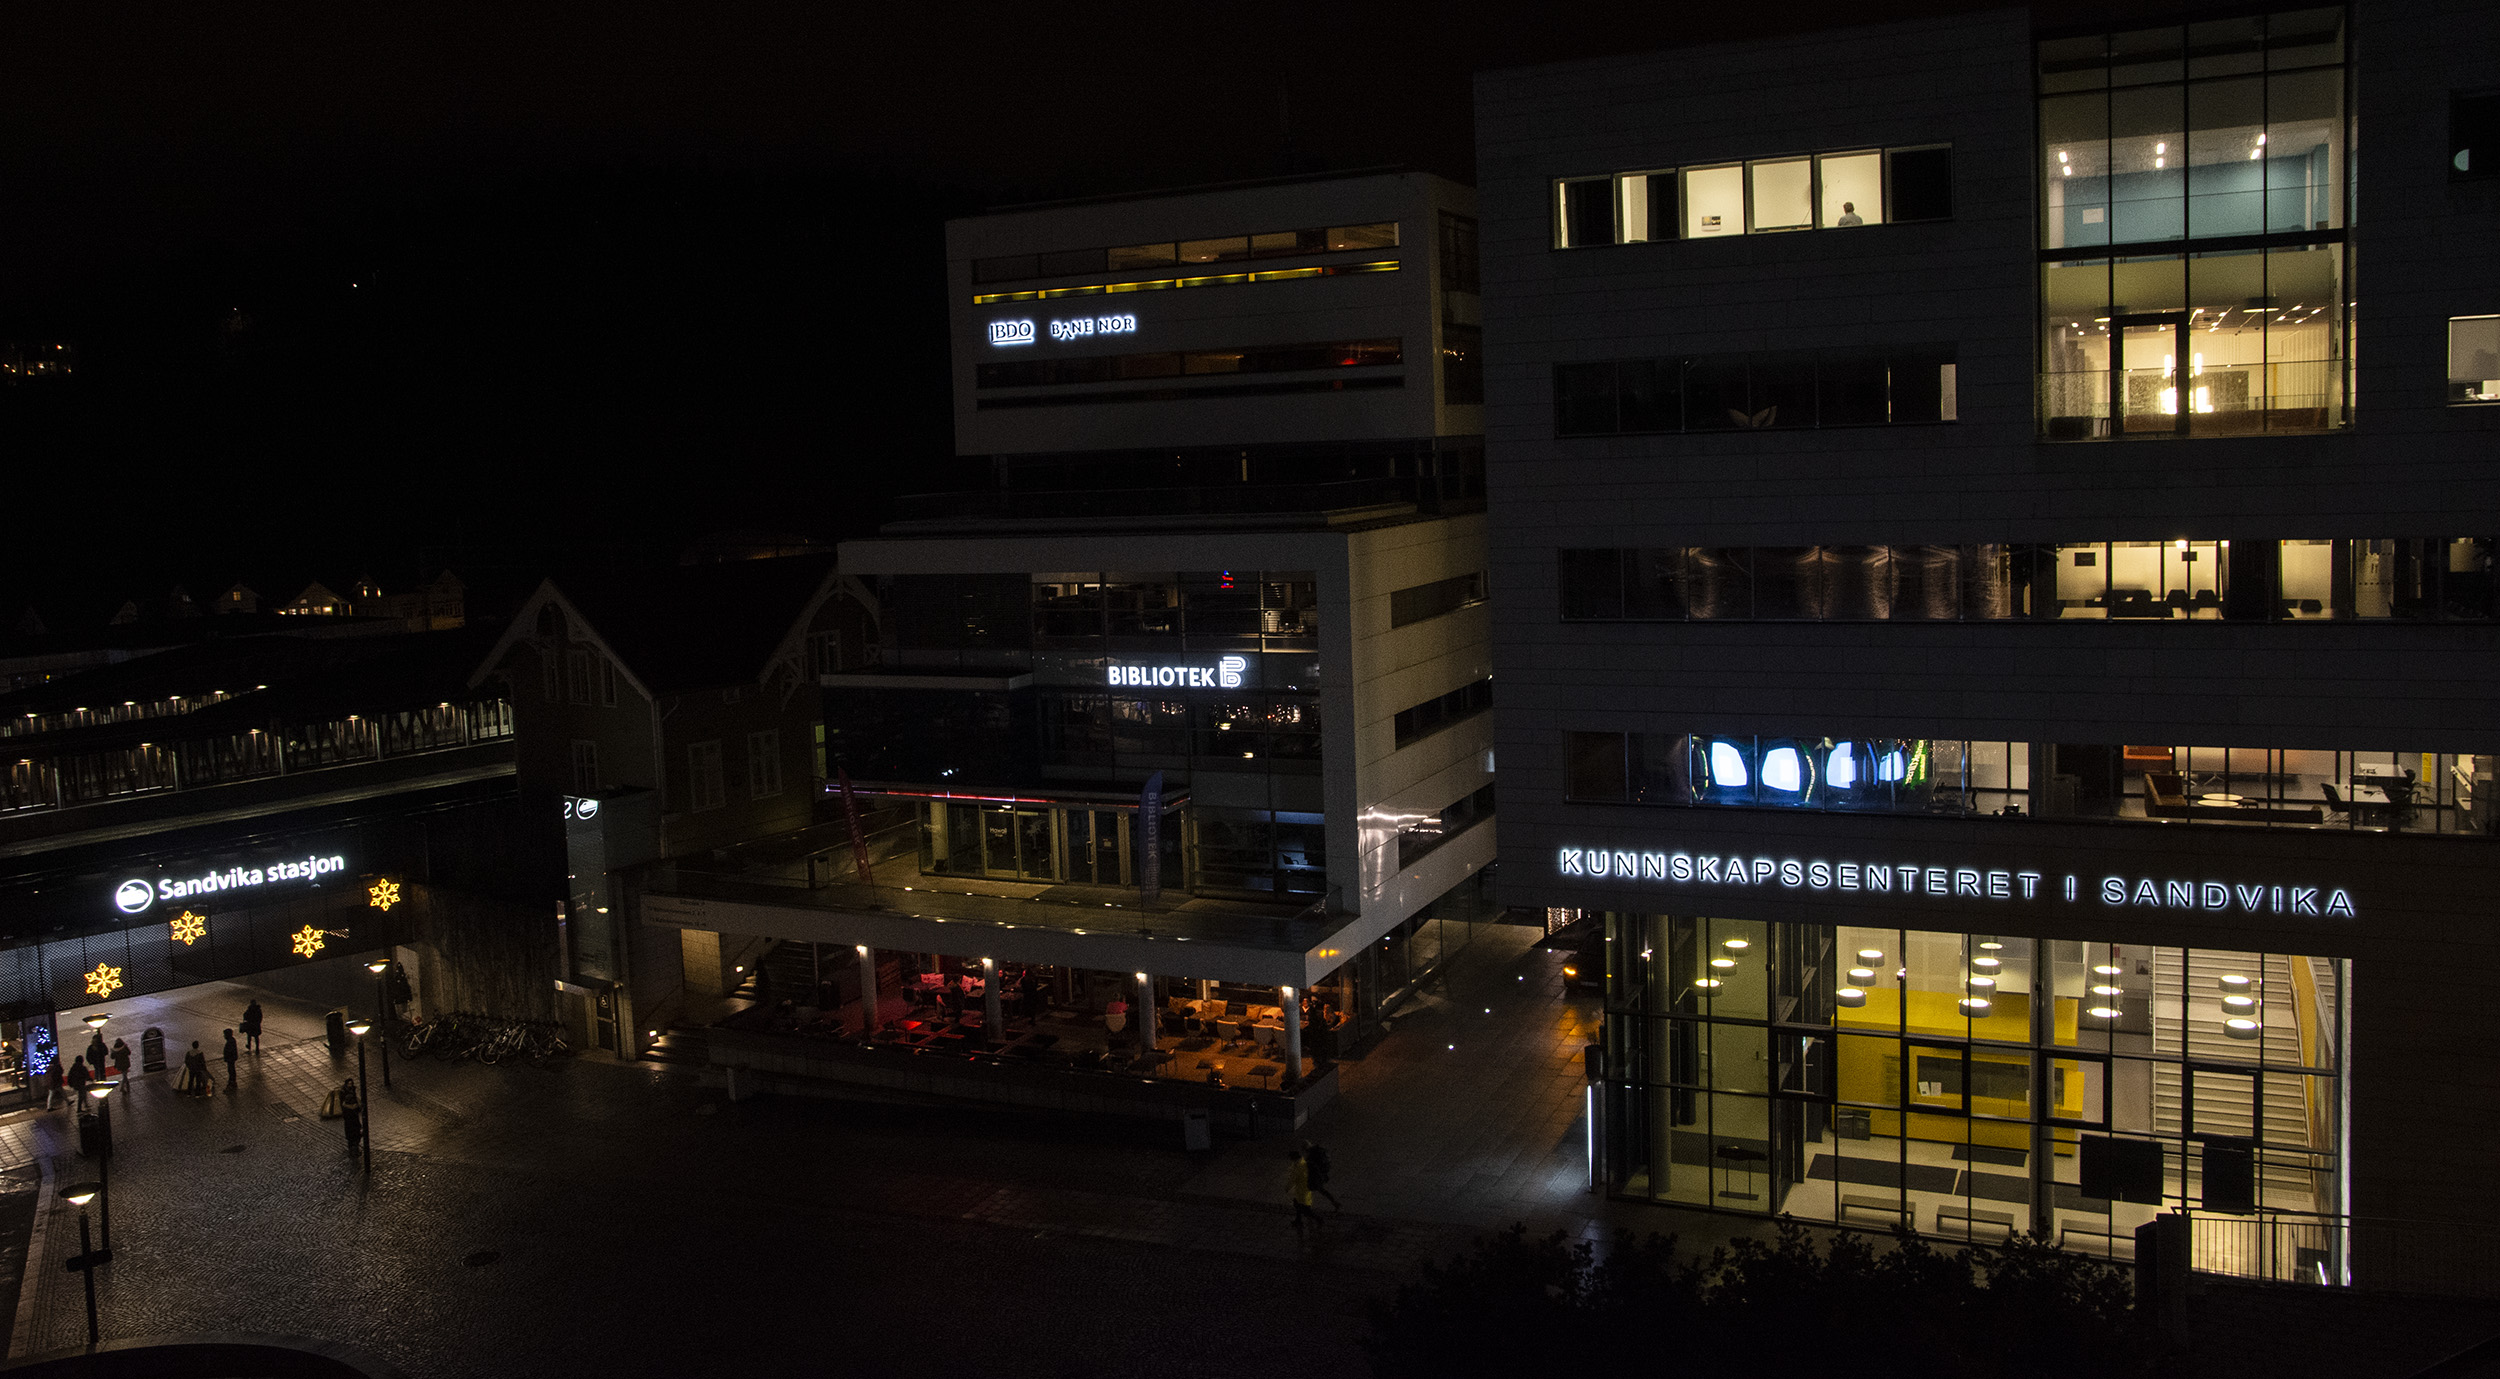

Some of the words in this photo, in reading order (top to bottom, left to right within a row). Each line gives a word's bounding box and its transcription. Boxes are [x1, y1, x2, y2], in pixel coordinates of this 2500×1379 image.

[1051, 319, 1093, 339] BANE
[1097, 315, 1135, 333] NOR
[1108, 665, 1216, 688] BIBLIOTEK
[1147, 791, 1158, 858] BIBLIOTEK
[158, 867, 264, 900] Sandvika
[266, 855, 345, 881] stasjon
[1561, 850, 2040, 899] KUNNSKAPSSENTERET
[2066, 875, 2075, 901] I
[2102, 878, 2355, 917] SANDVIKA
